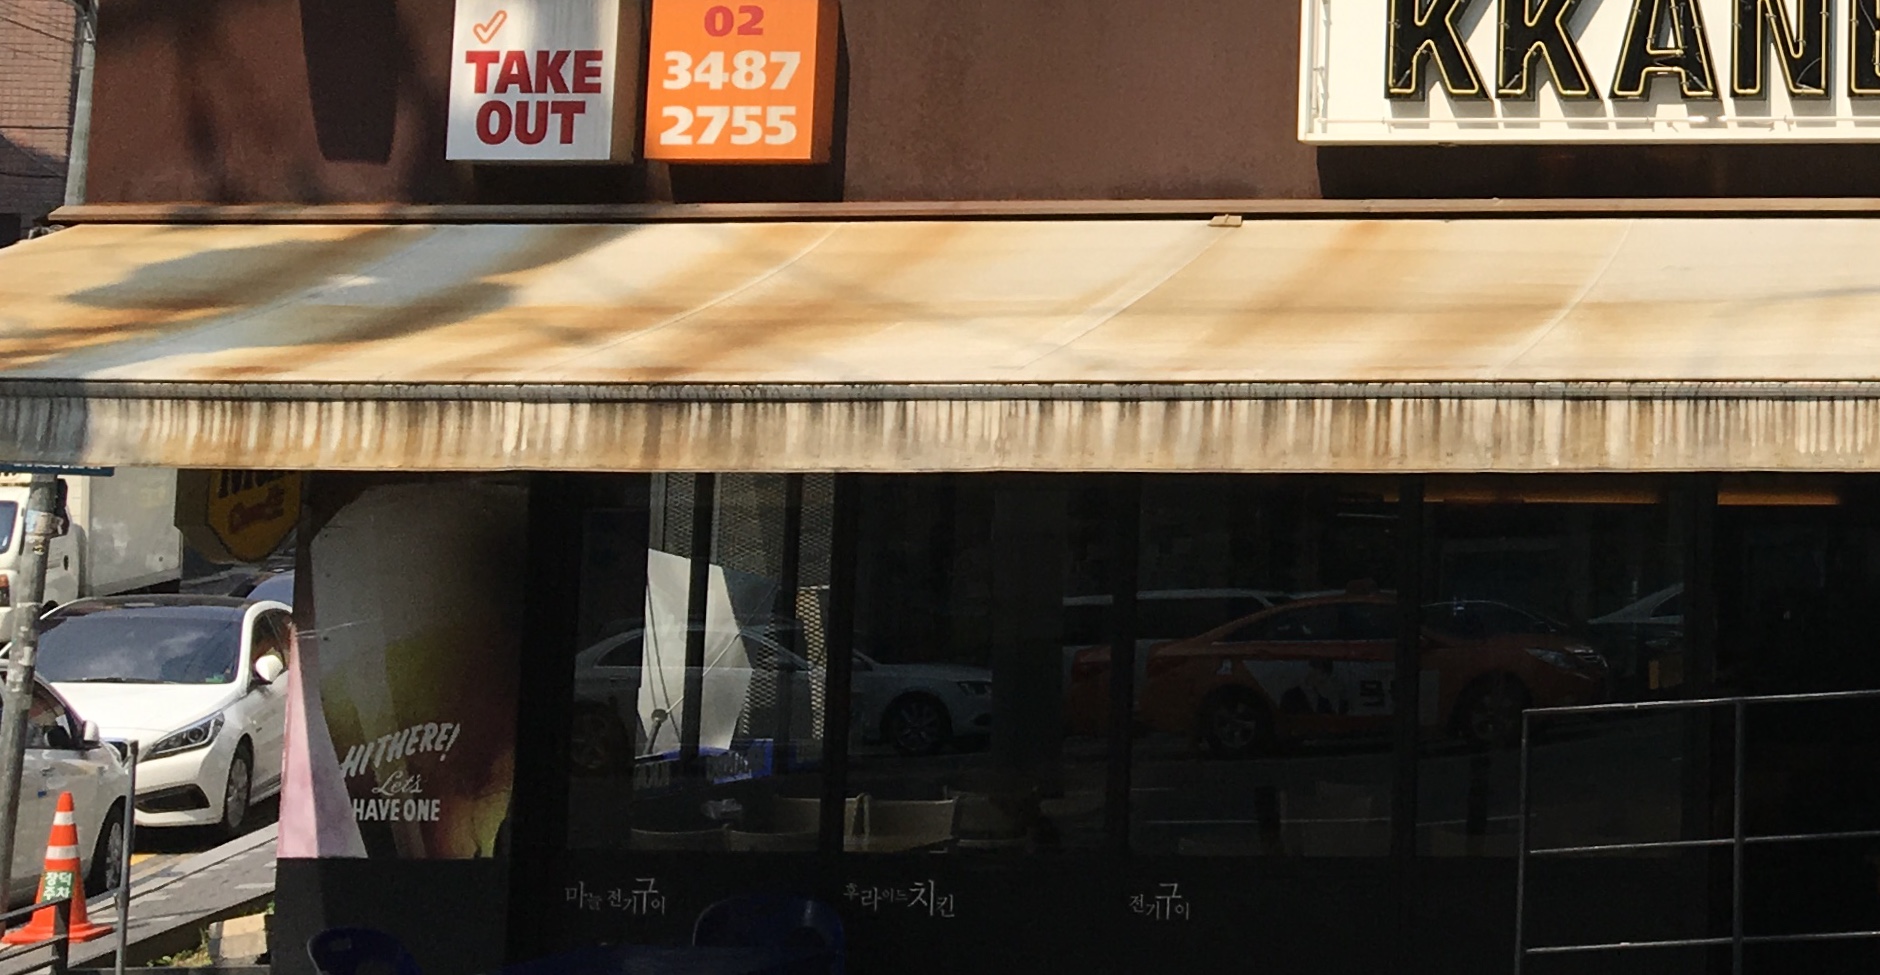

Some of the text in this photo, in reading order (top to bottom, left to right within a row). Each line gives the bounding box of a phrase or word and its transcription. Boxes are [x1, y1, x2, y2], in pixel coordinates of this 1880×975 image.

[704, 5, 765, 37] 02
[465, 50, 603, 94] TAKE
[662, 50, 801, 90] 3487
[476, 100, 586, 145] OUT
[660, 105, 798, 145] 2755
[371, 770, 423, 796] Let's
[353, 798, 441, 822] HAVE ONE
[607, 877, 665, 916] 전기구이
[1129, 882, 1190, 921] 전기구이
